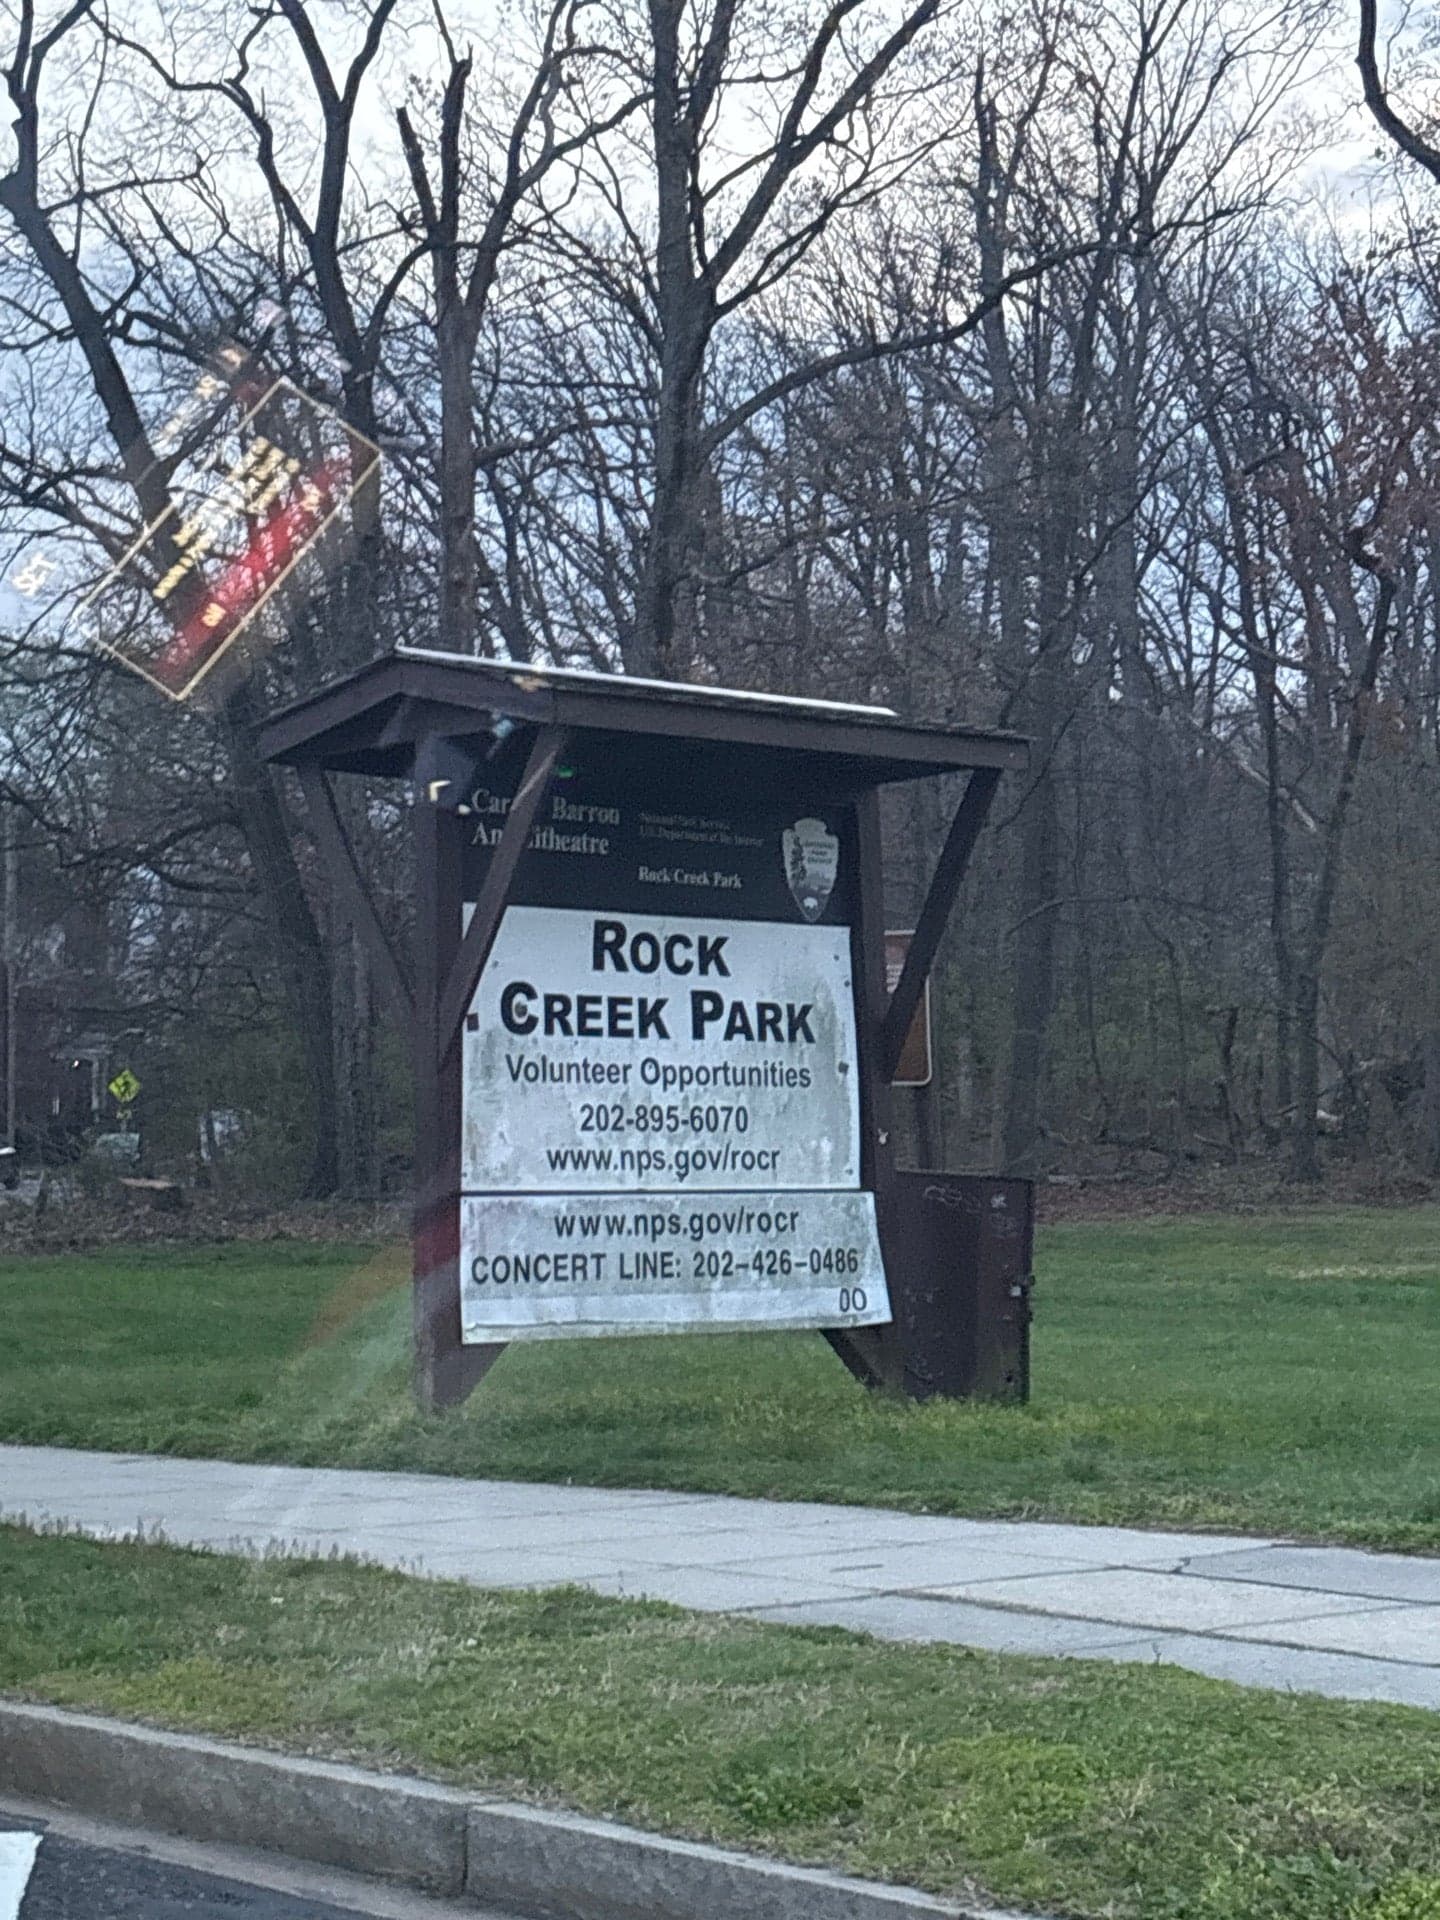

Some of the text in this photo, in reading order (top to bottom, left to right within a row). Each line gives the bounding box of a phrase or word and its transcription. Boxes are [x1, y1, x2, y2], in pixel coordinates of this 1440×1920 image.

[552, 795, 620, 825] Barron
[638, 866, 742, 889] Rock Creek Park
[592, 919, 731, 977] ROCK
[500, 981, 816, 1044] CREEK PARK
[505, 1053, 812, 1092] Volunteer Opportunities
[579, 1103, 749, 1133] 202-895-6070
[547, 1140, 780, 1182] www.nps.gov/rocr
[553, 1206, 799, 1242] www.nps.gov/rocr
[471, 1247, 858, 1285] CONCERT LINE: 202-426-0486
